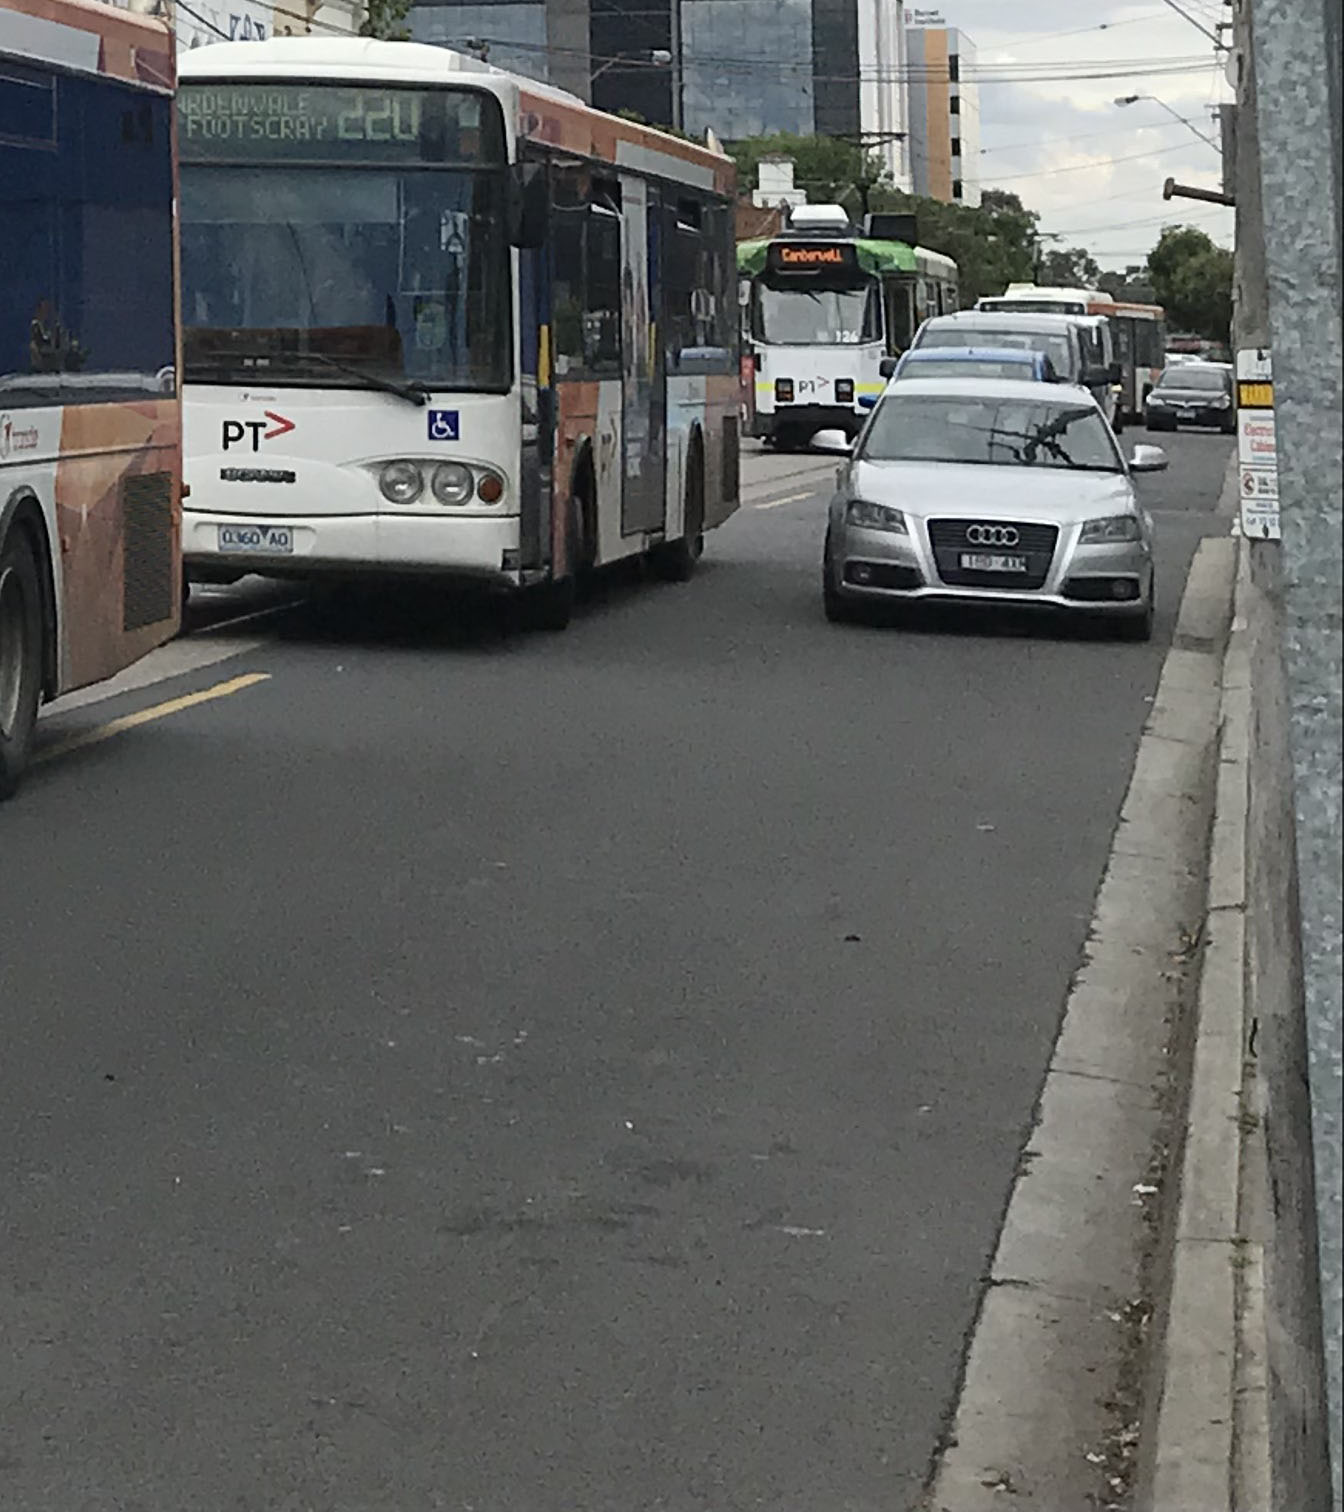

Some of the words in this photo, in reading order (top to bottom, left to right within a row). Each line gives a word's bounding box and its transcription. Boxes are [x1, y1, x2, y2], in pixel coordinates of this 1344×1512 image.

[178, 91, 311, 115] ARDENVALE
[337, 88, 420, 141] 220
[187, 115, 328, 139] FOOTSCRAY
[835, 330, 860, 344] 126
[223, 420, 268, 453] PT
